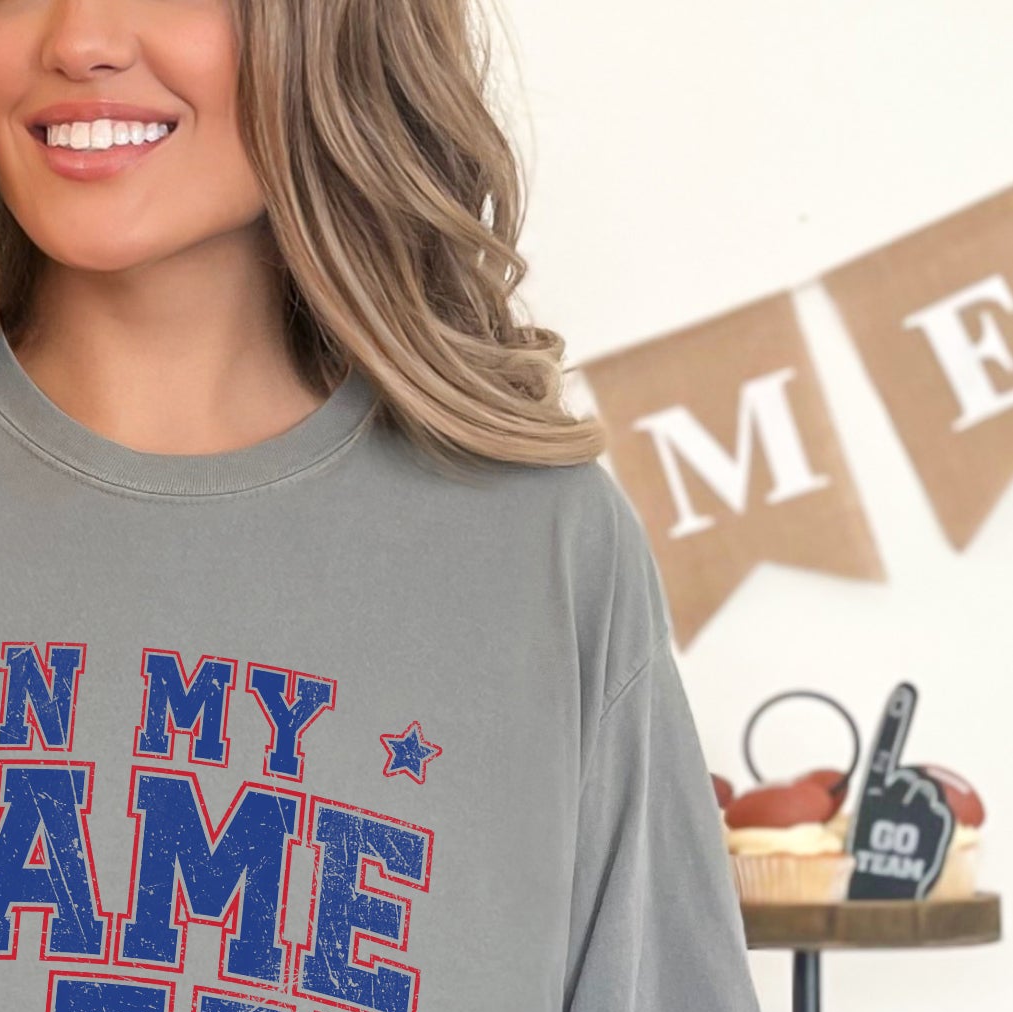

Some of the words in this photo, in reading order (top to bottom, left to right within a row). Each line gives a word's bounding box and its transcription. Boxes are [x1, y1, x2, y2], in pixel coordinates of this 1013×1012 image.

[132, 647, 337, 782] MY
[869, 819, 920, 855] GO
[857, 850, 925, 881] TEAM
